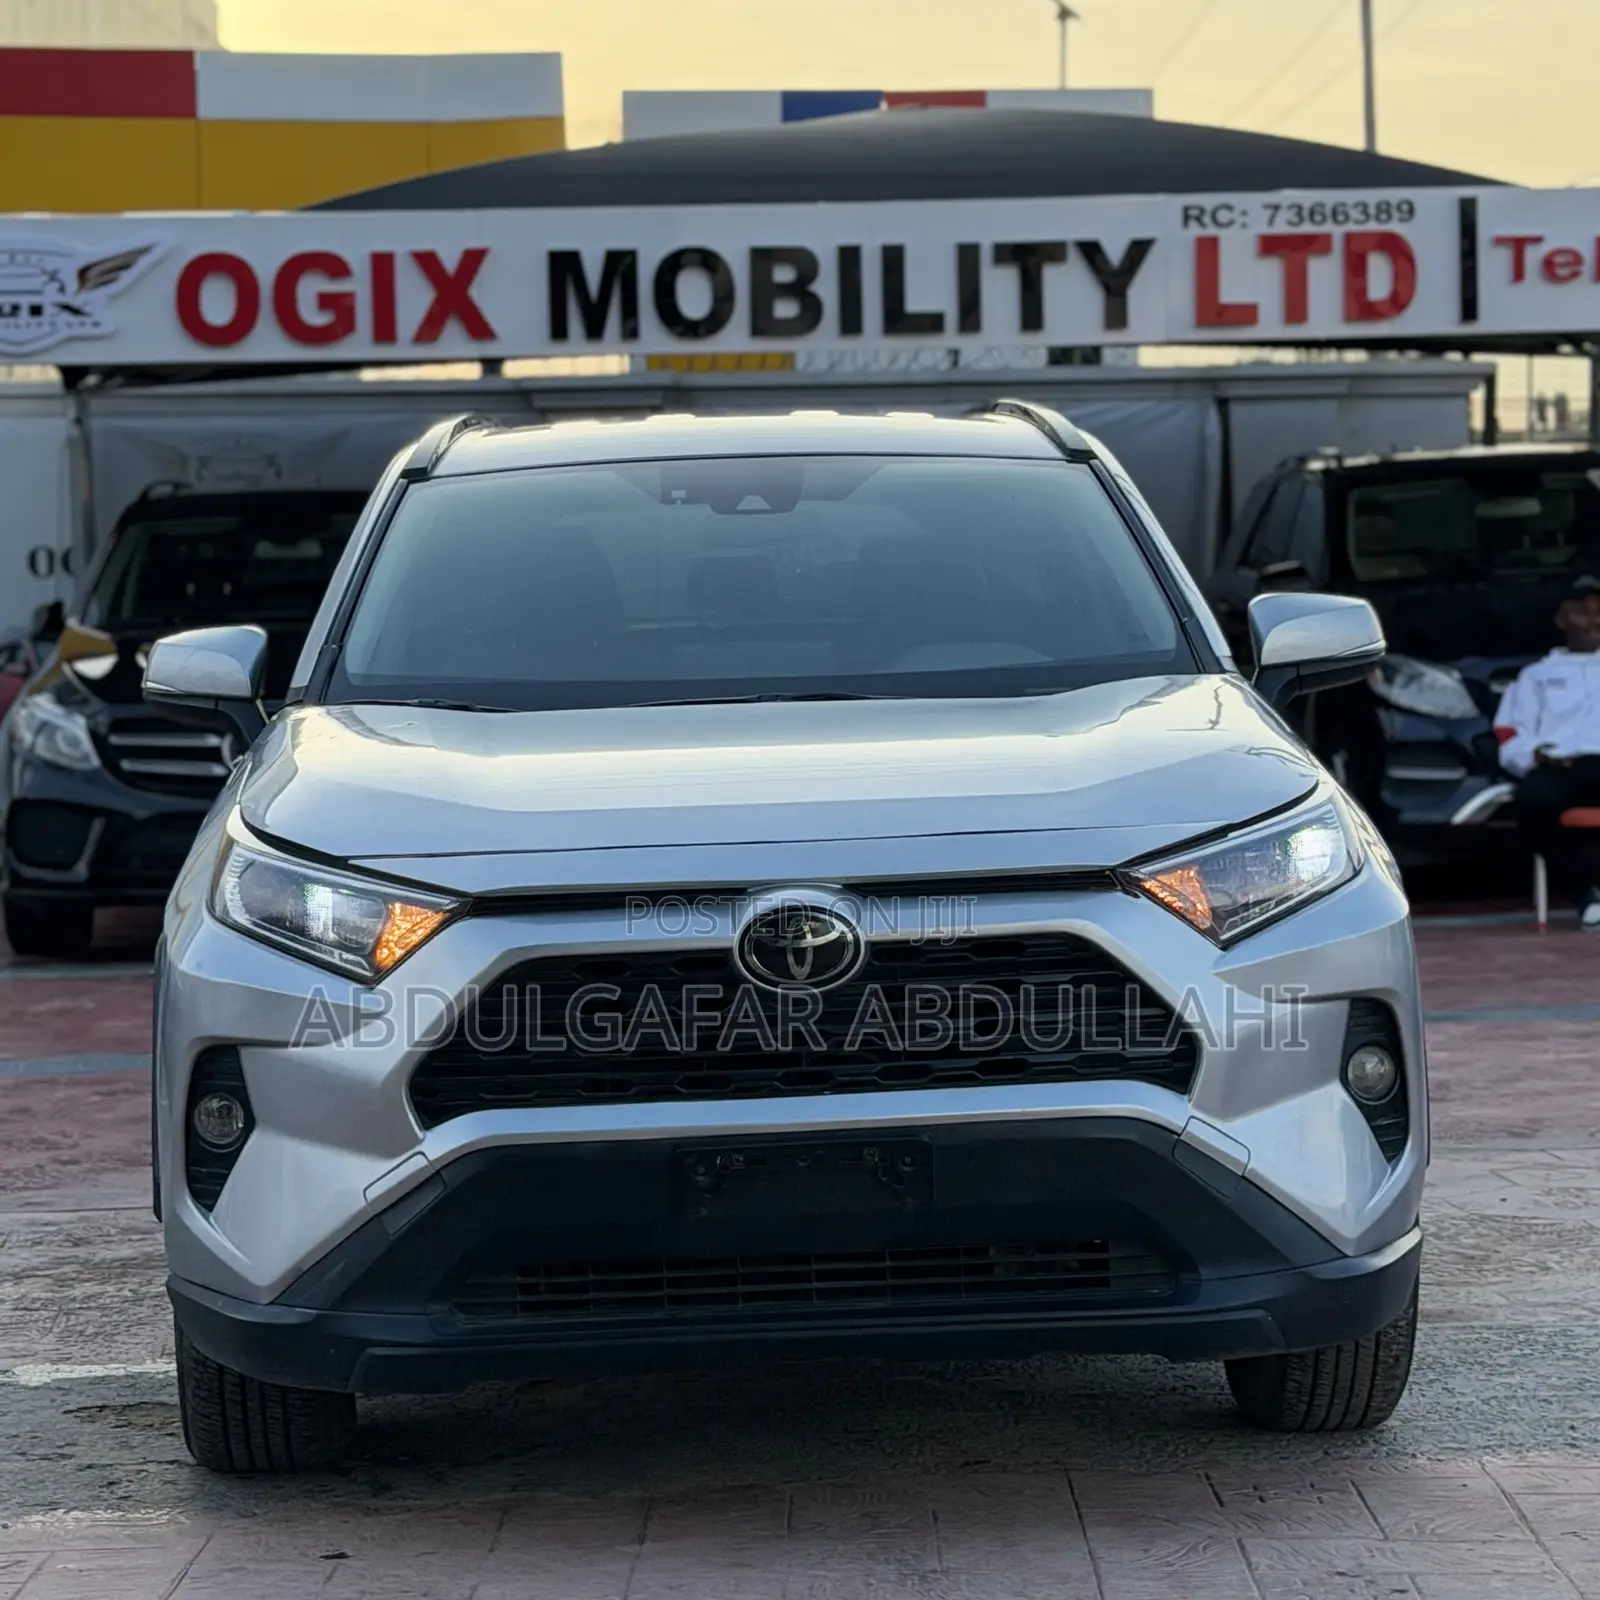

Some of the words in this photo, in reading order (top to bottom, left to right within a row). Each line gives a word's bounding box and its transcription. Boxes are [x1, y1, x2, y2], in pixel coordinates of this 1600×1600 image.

[1182, 203, 1248, 229] RC:
[1262, 200, 1416, 227] 7366389
[176, 247, 497, 347] OGIX
[547, 238, 1157, 342] MOBILITY
[1195, 231, 1417, 326] LTD
